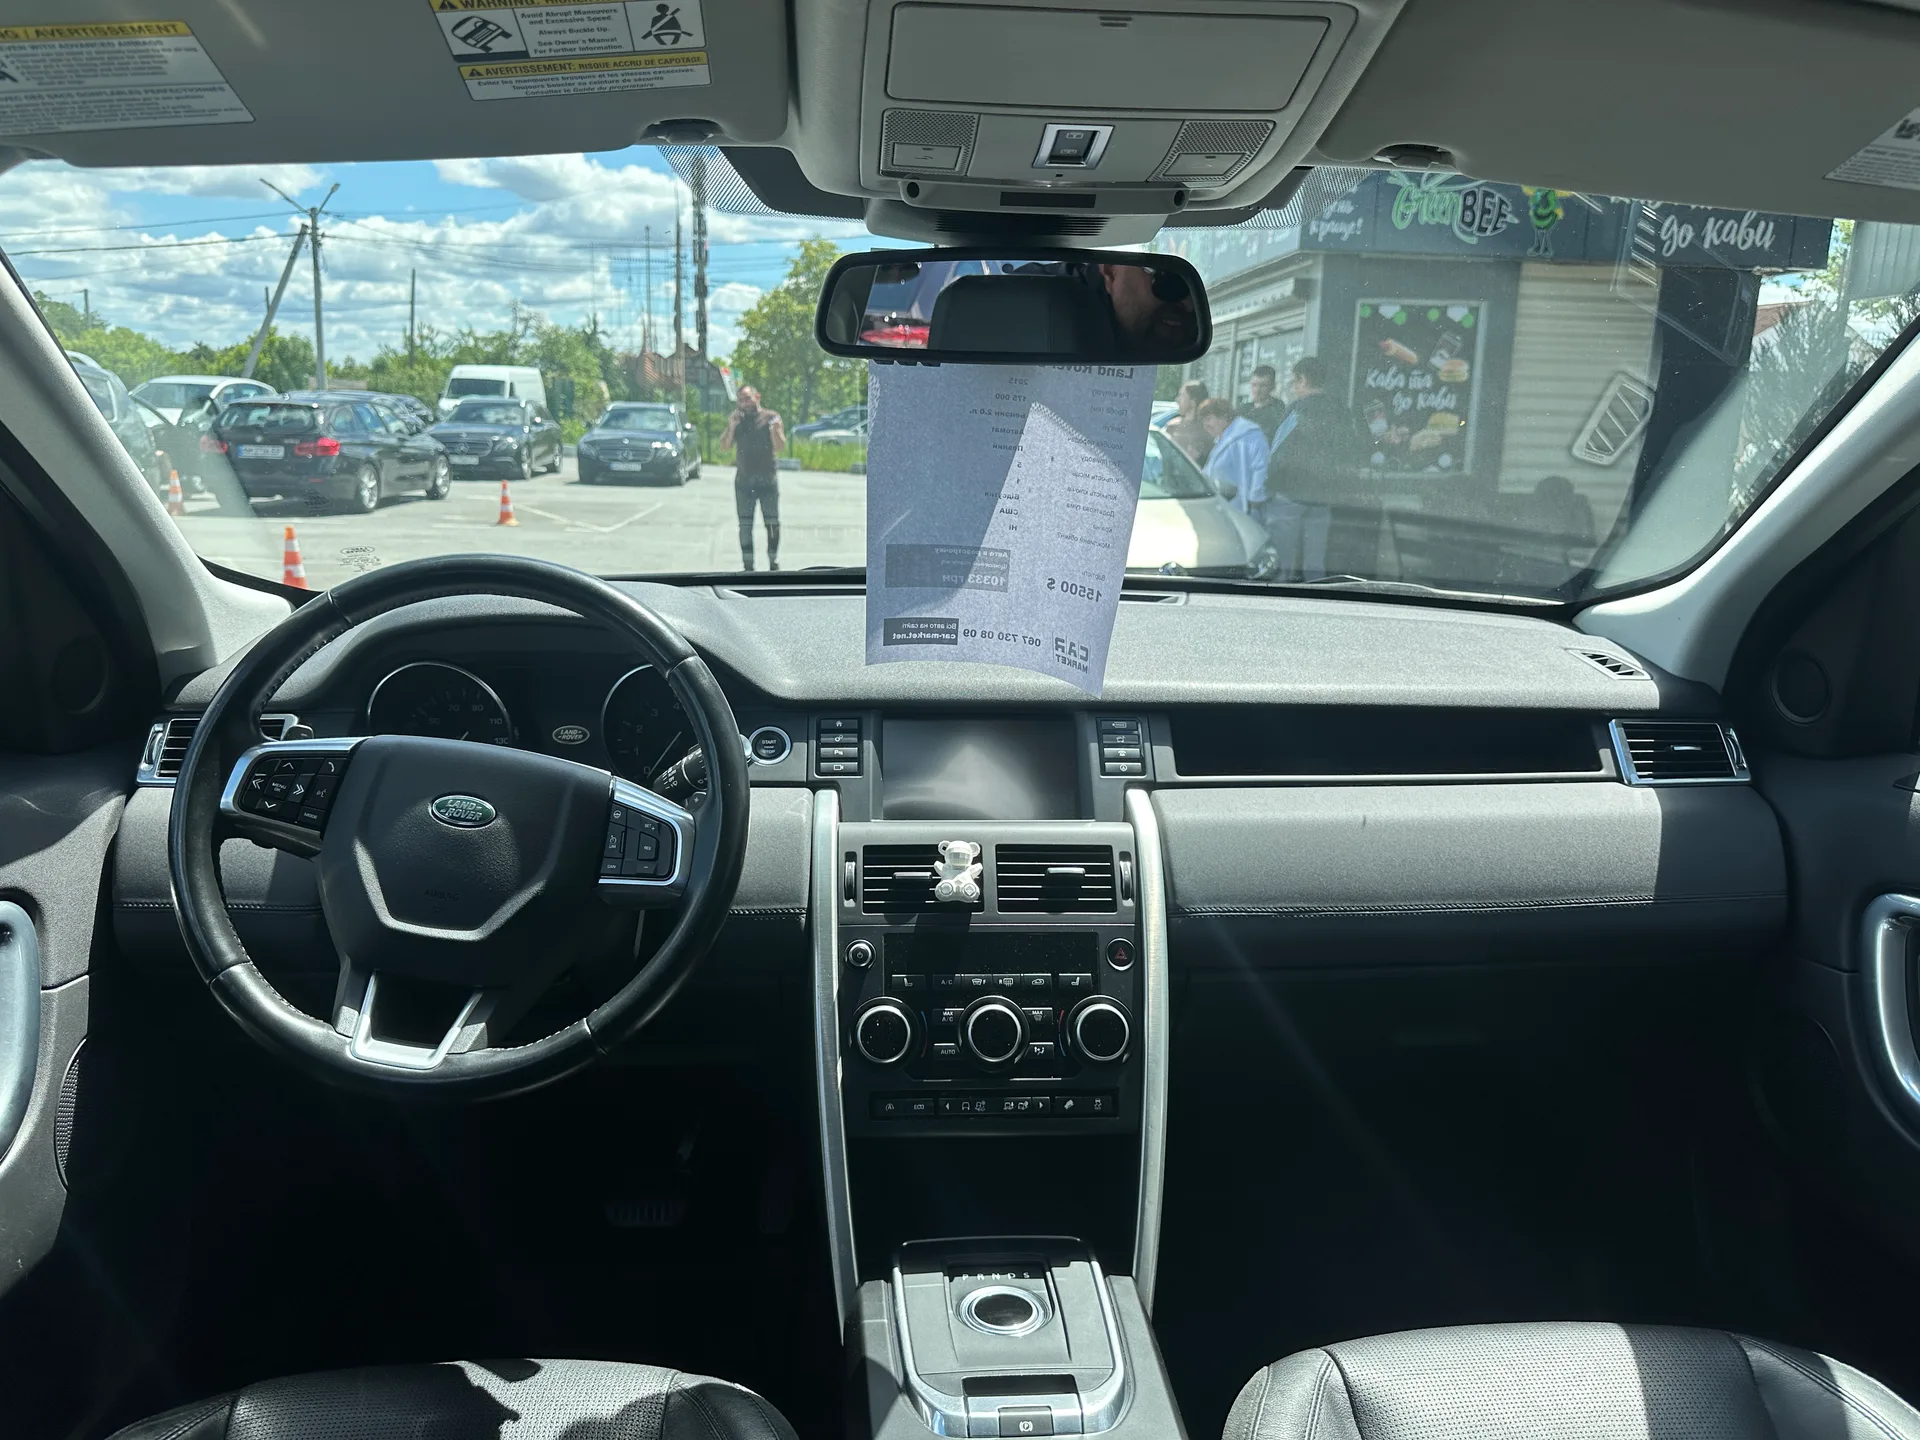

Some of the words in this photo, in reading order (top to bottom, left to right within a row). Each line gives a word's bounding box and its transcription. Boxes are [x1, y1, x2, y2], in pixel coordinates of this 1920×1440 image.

[521, 11, 544, 19] Avoid
[545, 9, 572, 18] Abrupt
[573, 8, 618, 16] Maneuvers
[545, 17, 585, 25] Excessive
[34, 24, 179, 38] AVERTISSEMENT
[539, 28, 567, 37] Always
[569, 26, 595, 35] Buckle
[538, 39, 550, 47] See
[588, 36, 617, 44] Manual
[534, 47, 546, 55] For
[548, 45, 577, 54] Further
[485, 62, 576, 77] AVERTISSEMENT:
[579, 61, 610, 71] RISQUE
[613, 59, 642, 68] ACCRU
[643, 58, 653, 67] DE
[658, 56, 702, 65] CAPOTAGE
[1660, 215, 1695, 257] до
[1701, 209, 1776, 251] кави
[448, 704, 460, 712] 70
[446, 799, 476, 811] LAND
[303, 812, 319, 820] MODE
[445, 807, 483, 821] ROVER
